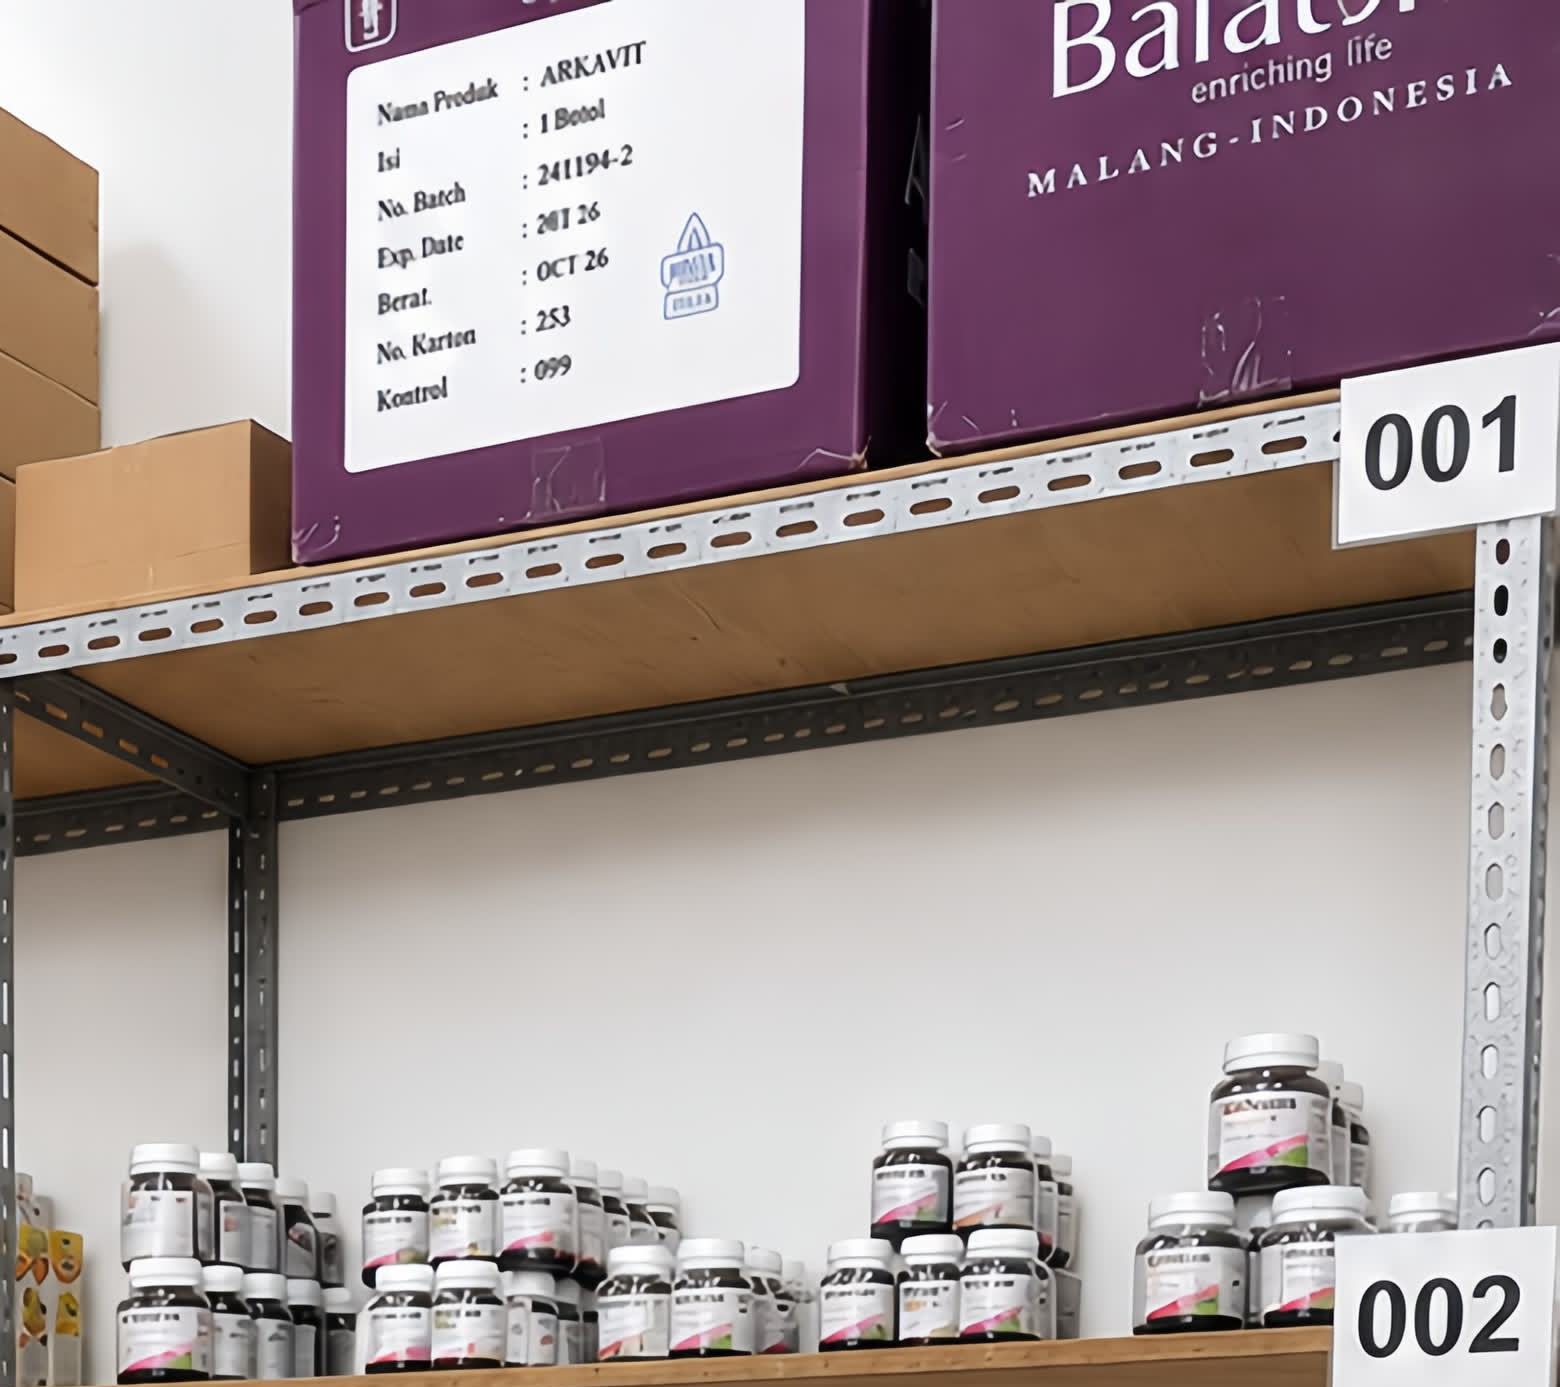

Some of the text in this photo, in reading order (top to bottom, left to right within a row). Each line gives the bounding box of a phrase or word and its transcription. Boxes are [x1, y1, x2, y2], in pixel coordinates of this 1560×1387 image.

[1191, 33, 1393, 104] enriching life
[378, 101, 429, 126] Nama
[378, 148, 400, 172] Isi
[414, 181, 466, 213] Batch
[422, 235, 464, 258] Date
[537, 255, 577, 281] OCT
[584, 247, 609, 271] 26
[412, 329, 476, 357] Karton
[1364, 395, 1516, 491] 001
[1357, 1274, 1520, 1358] 002
